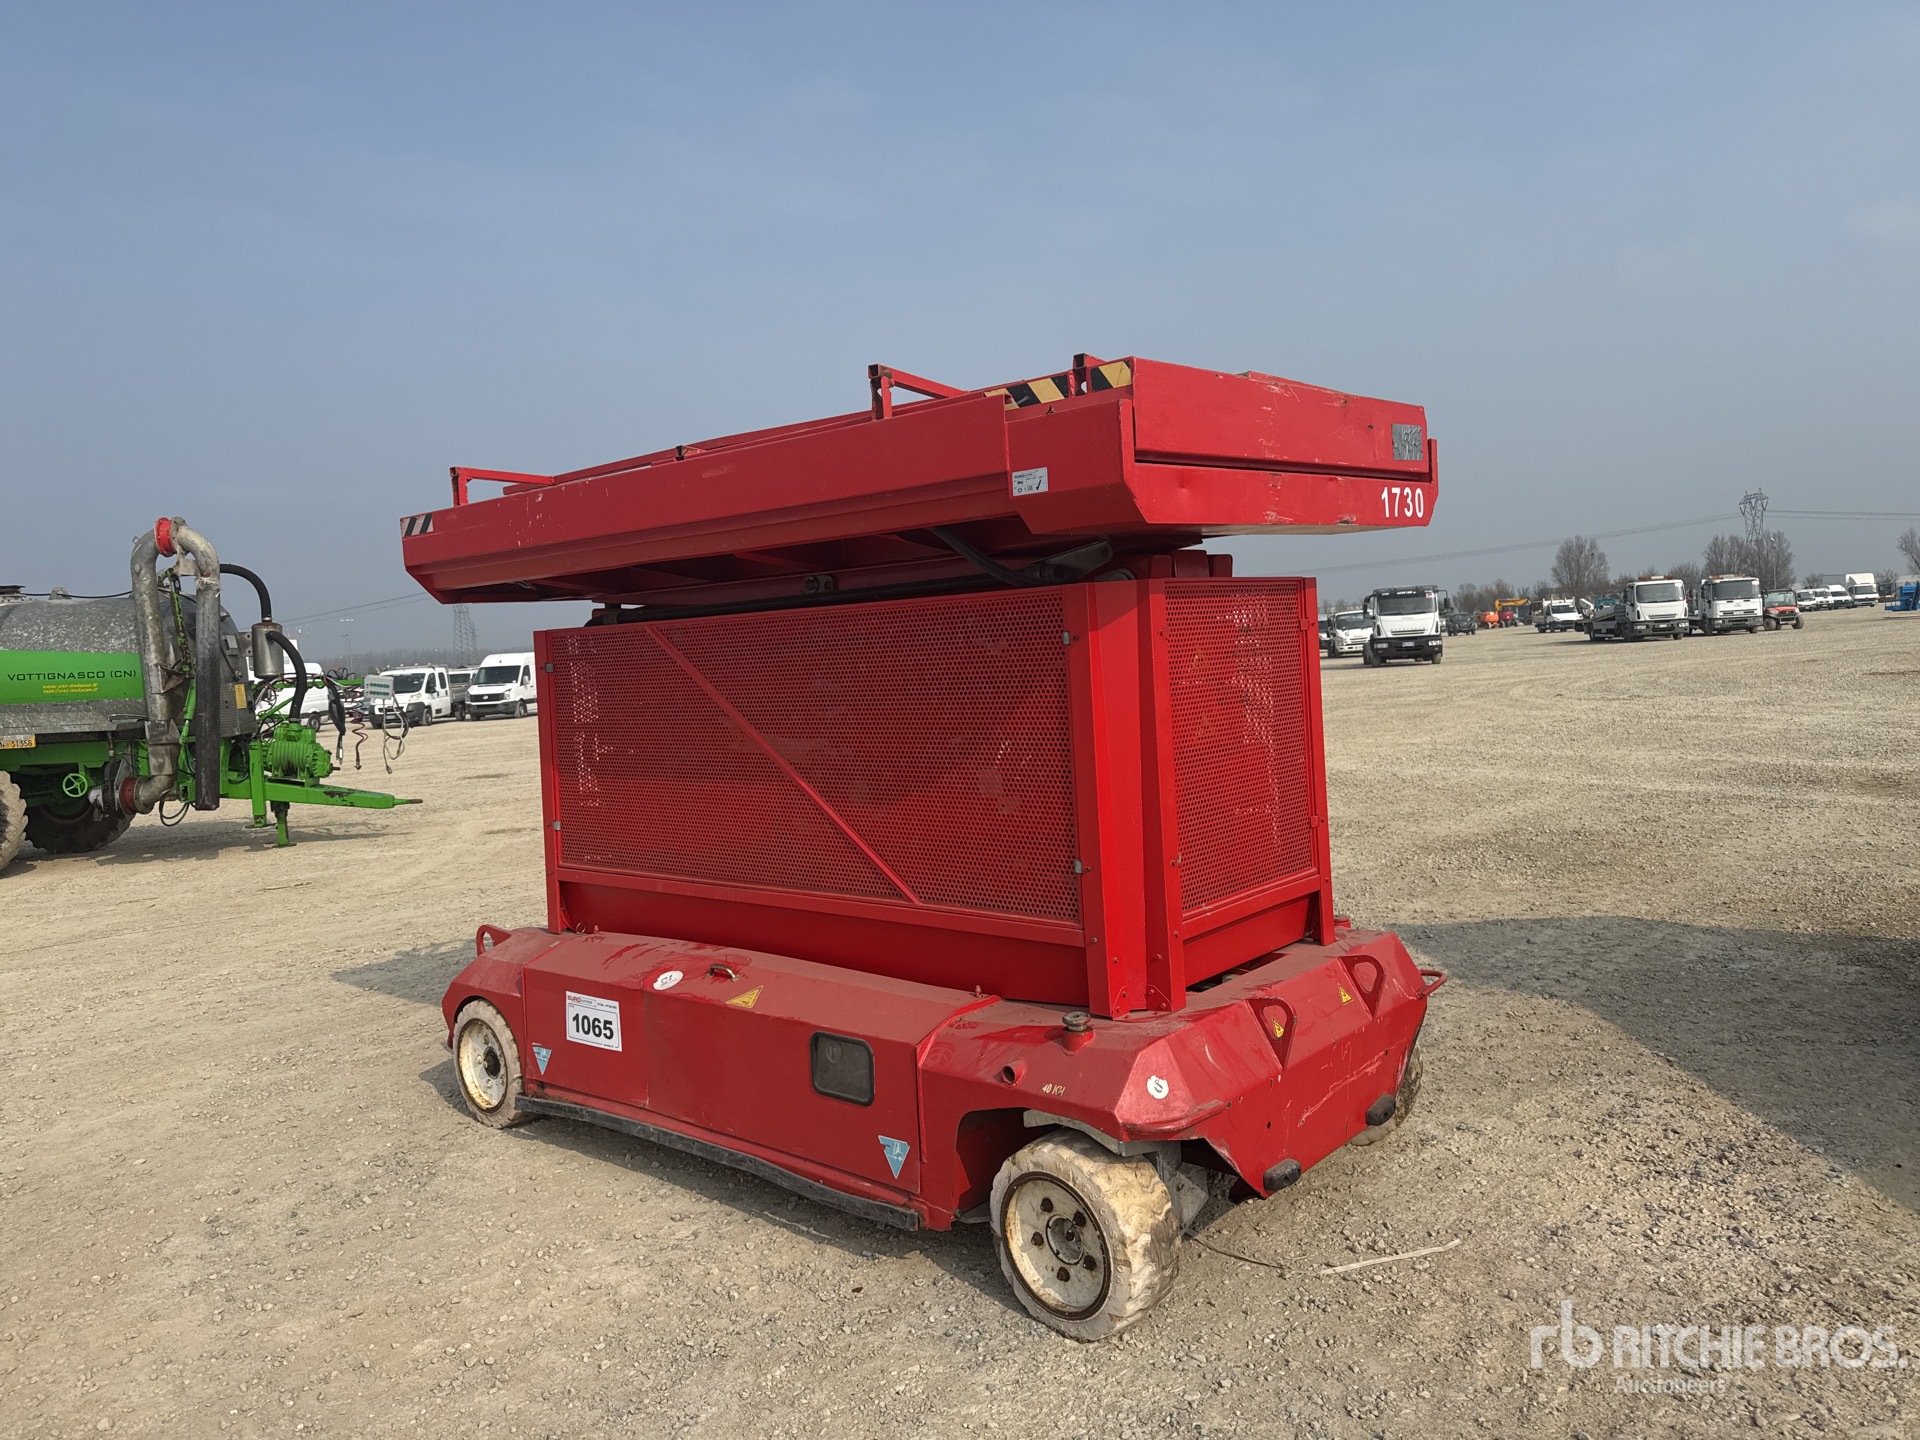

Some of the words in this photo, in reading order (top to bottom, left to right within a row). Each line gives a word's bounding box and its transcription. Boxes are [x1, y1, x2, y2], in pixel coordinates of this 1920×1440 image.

[1381, 487, 1424, 518] 1730
[7, 670, 106, 681] VOTTIGNASCO
[110, 669, 137, 679] (CN)
[572, 1013, 614, 1040] 1065
